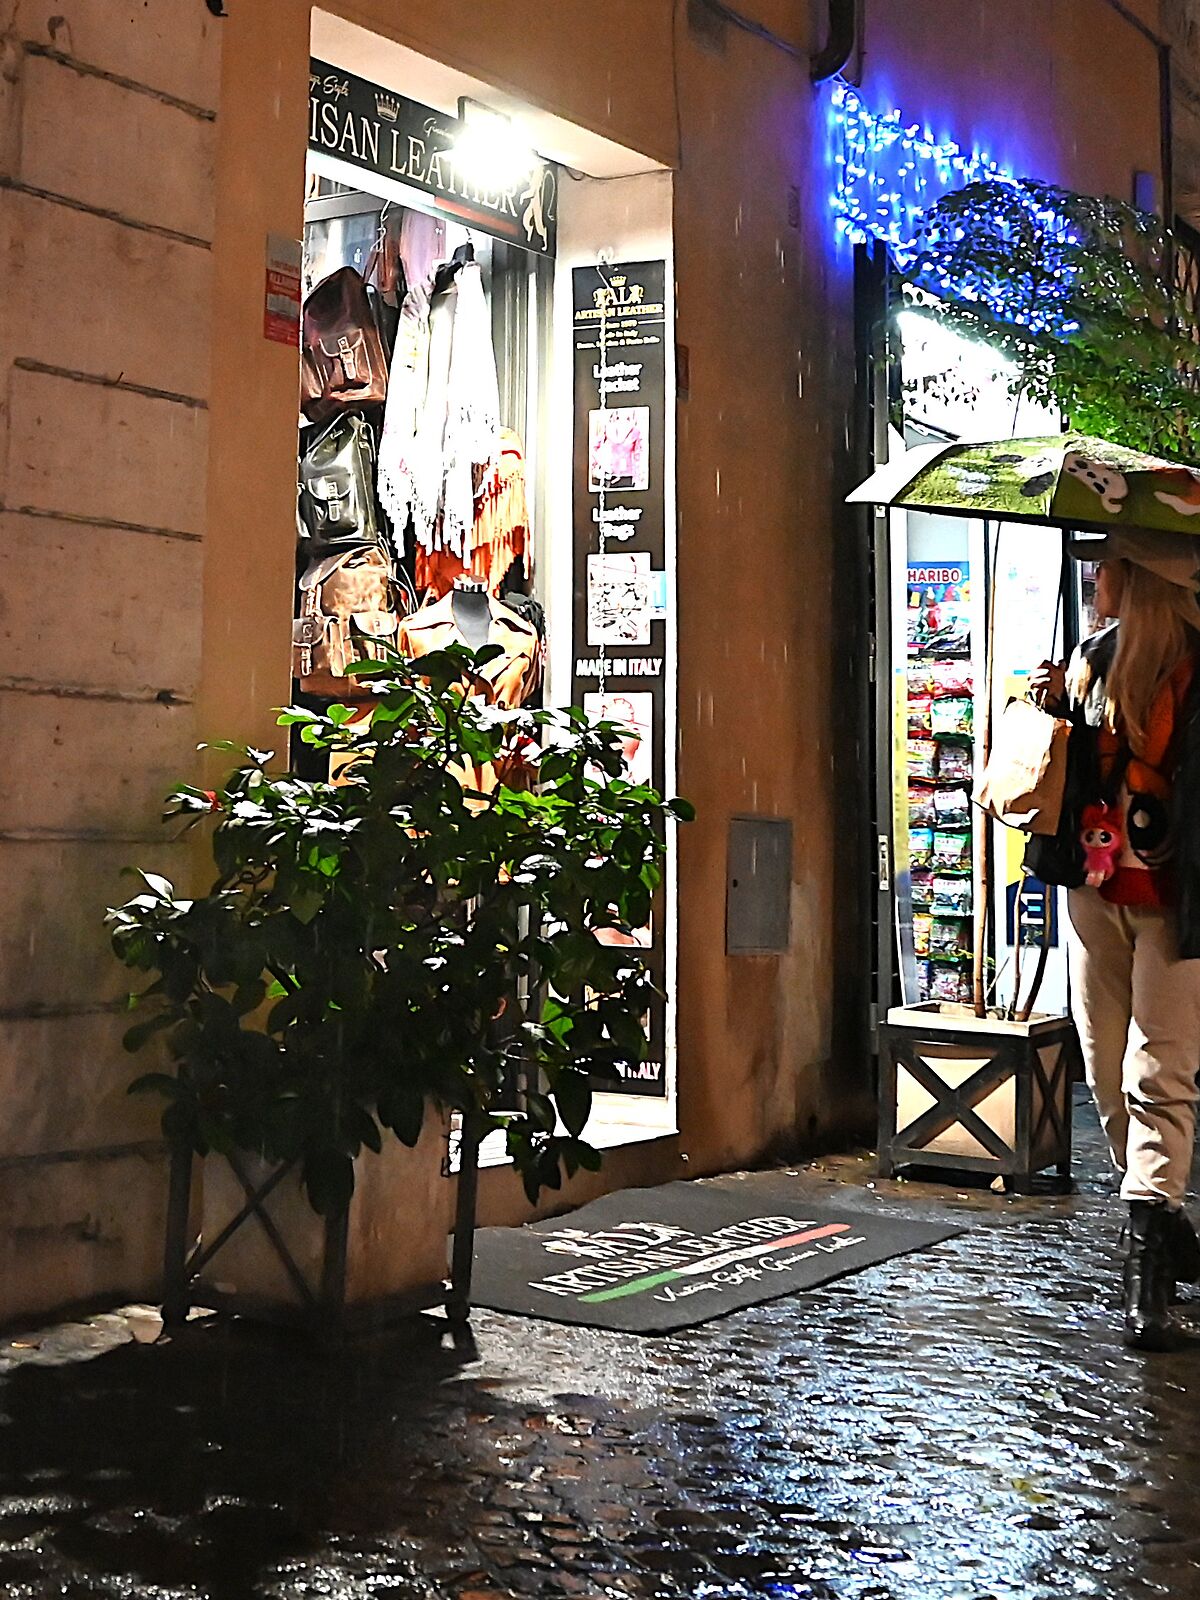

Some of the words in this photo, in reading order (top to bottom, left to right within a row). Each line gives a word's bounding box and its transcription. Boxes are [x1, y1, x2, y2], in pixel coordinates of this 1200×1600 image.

[308, 96, 381, 165] ISAN
[599, 377, 641, 394] acket
[907, 569, 960, 583] HARIBO
[575, 658, 613, 677] MADE
[612, 657, 628, 676] IN
[628, 657, 663, 677] ITALY
[528, 1246, 690, 1296] ARTISAN
[677, 1214, 818, 1258] LEATHER
